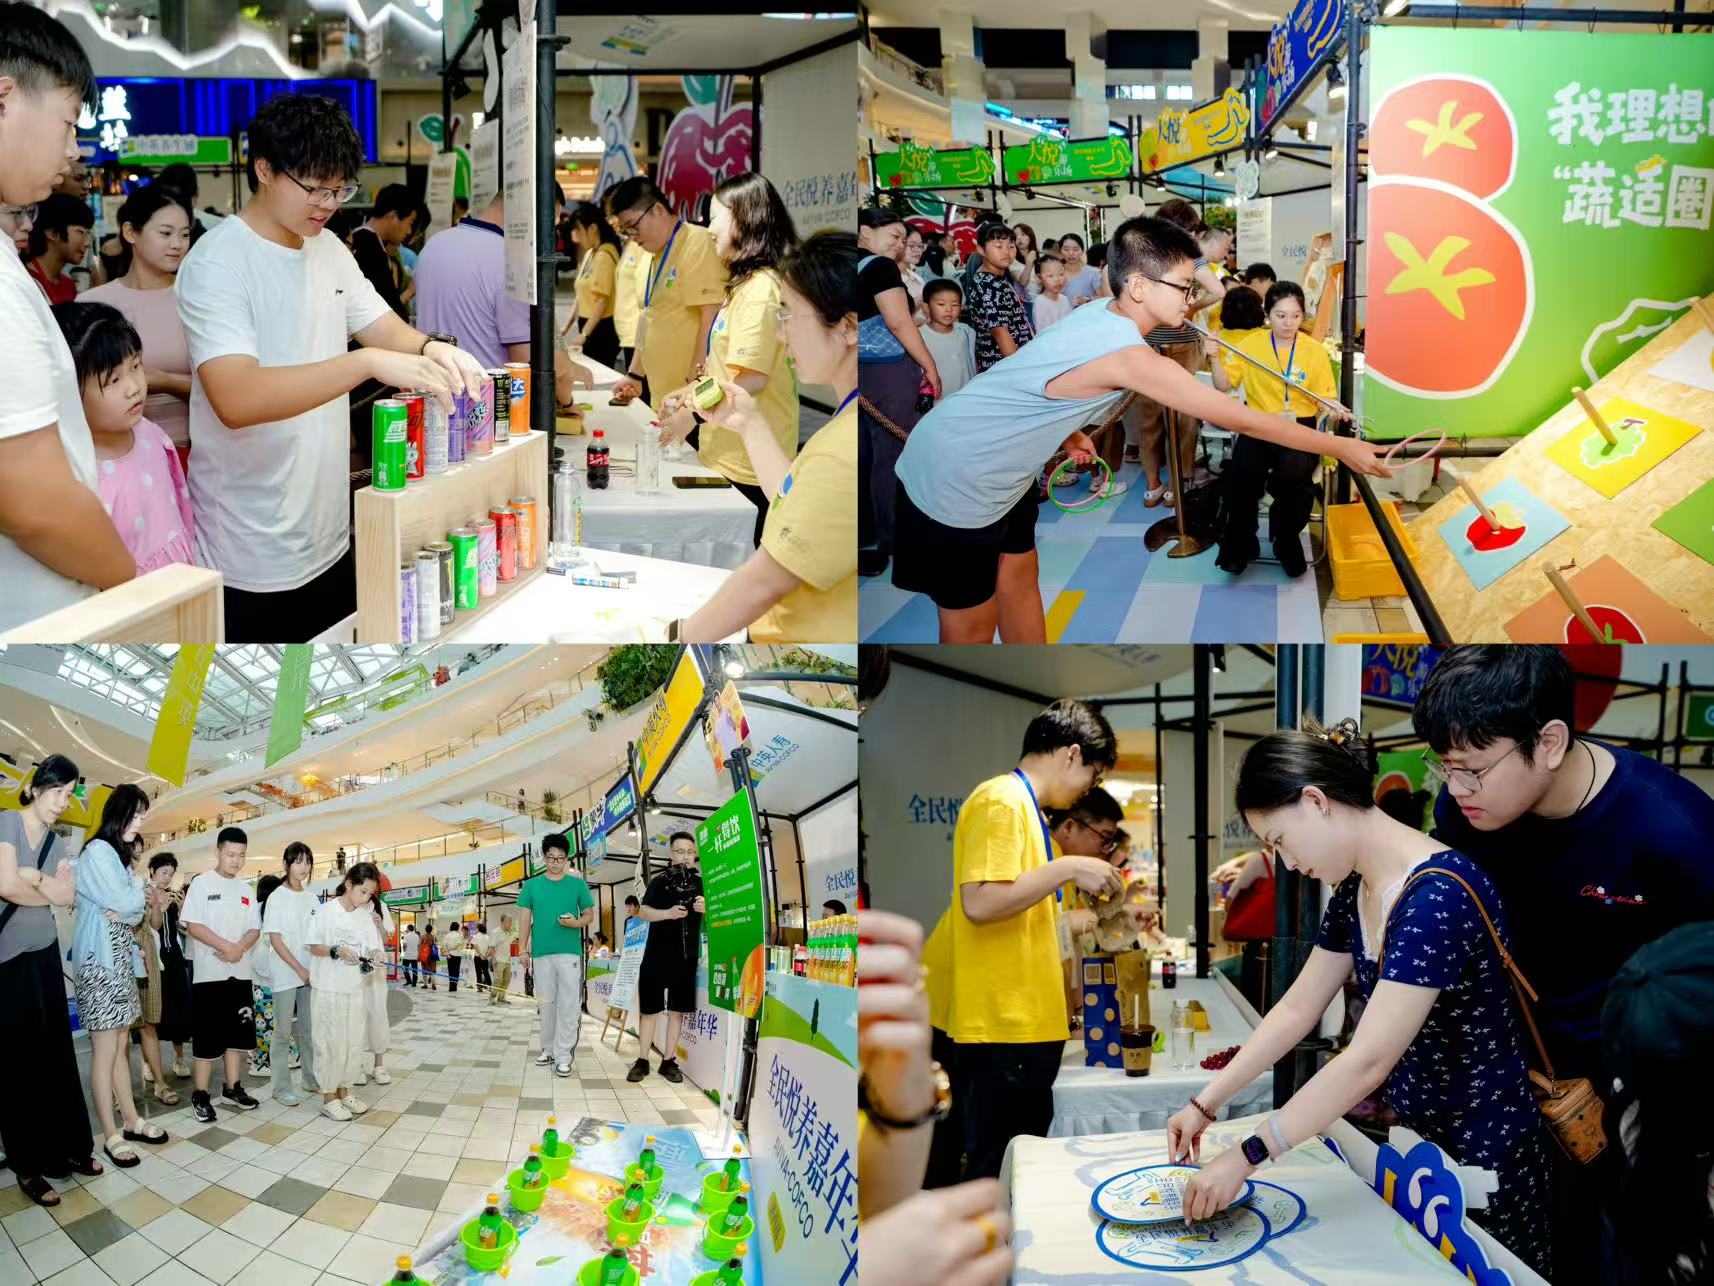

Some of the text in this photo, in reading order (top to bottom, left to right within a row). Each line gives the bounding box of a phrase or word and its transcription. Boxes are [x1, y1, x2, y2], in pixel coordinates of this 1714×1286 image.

[1547, 82, 1714, 146] 我理想
[750, 734, 791, 768] 中英人寿
